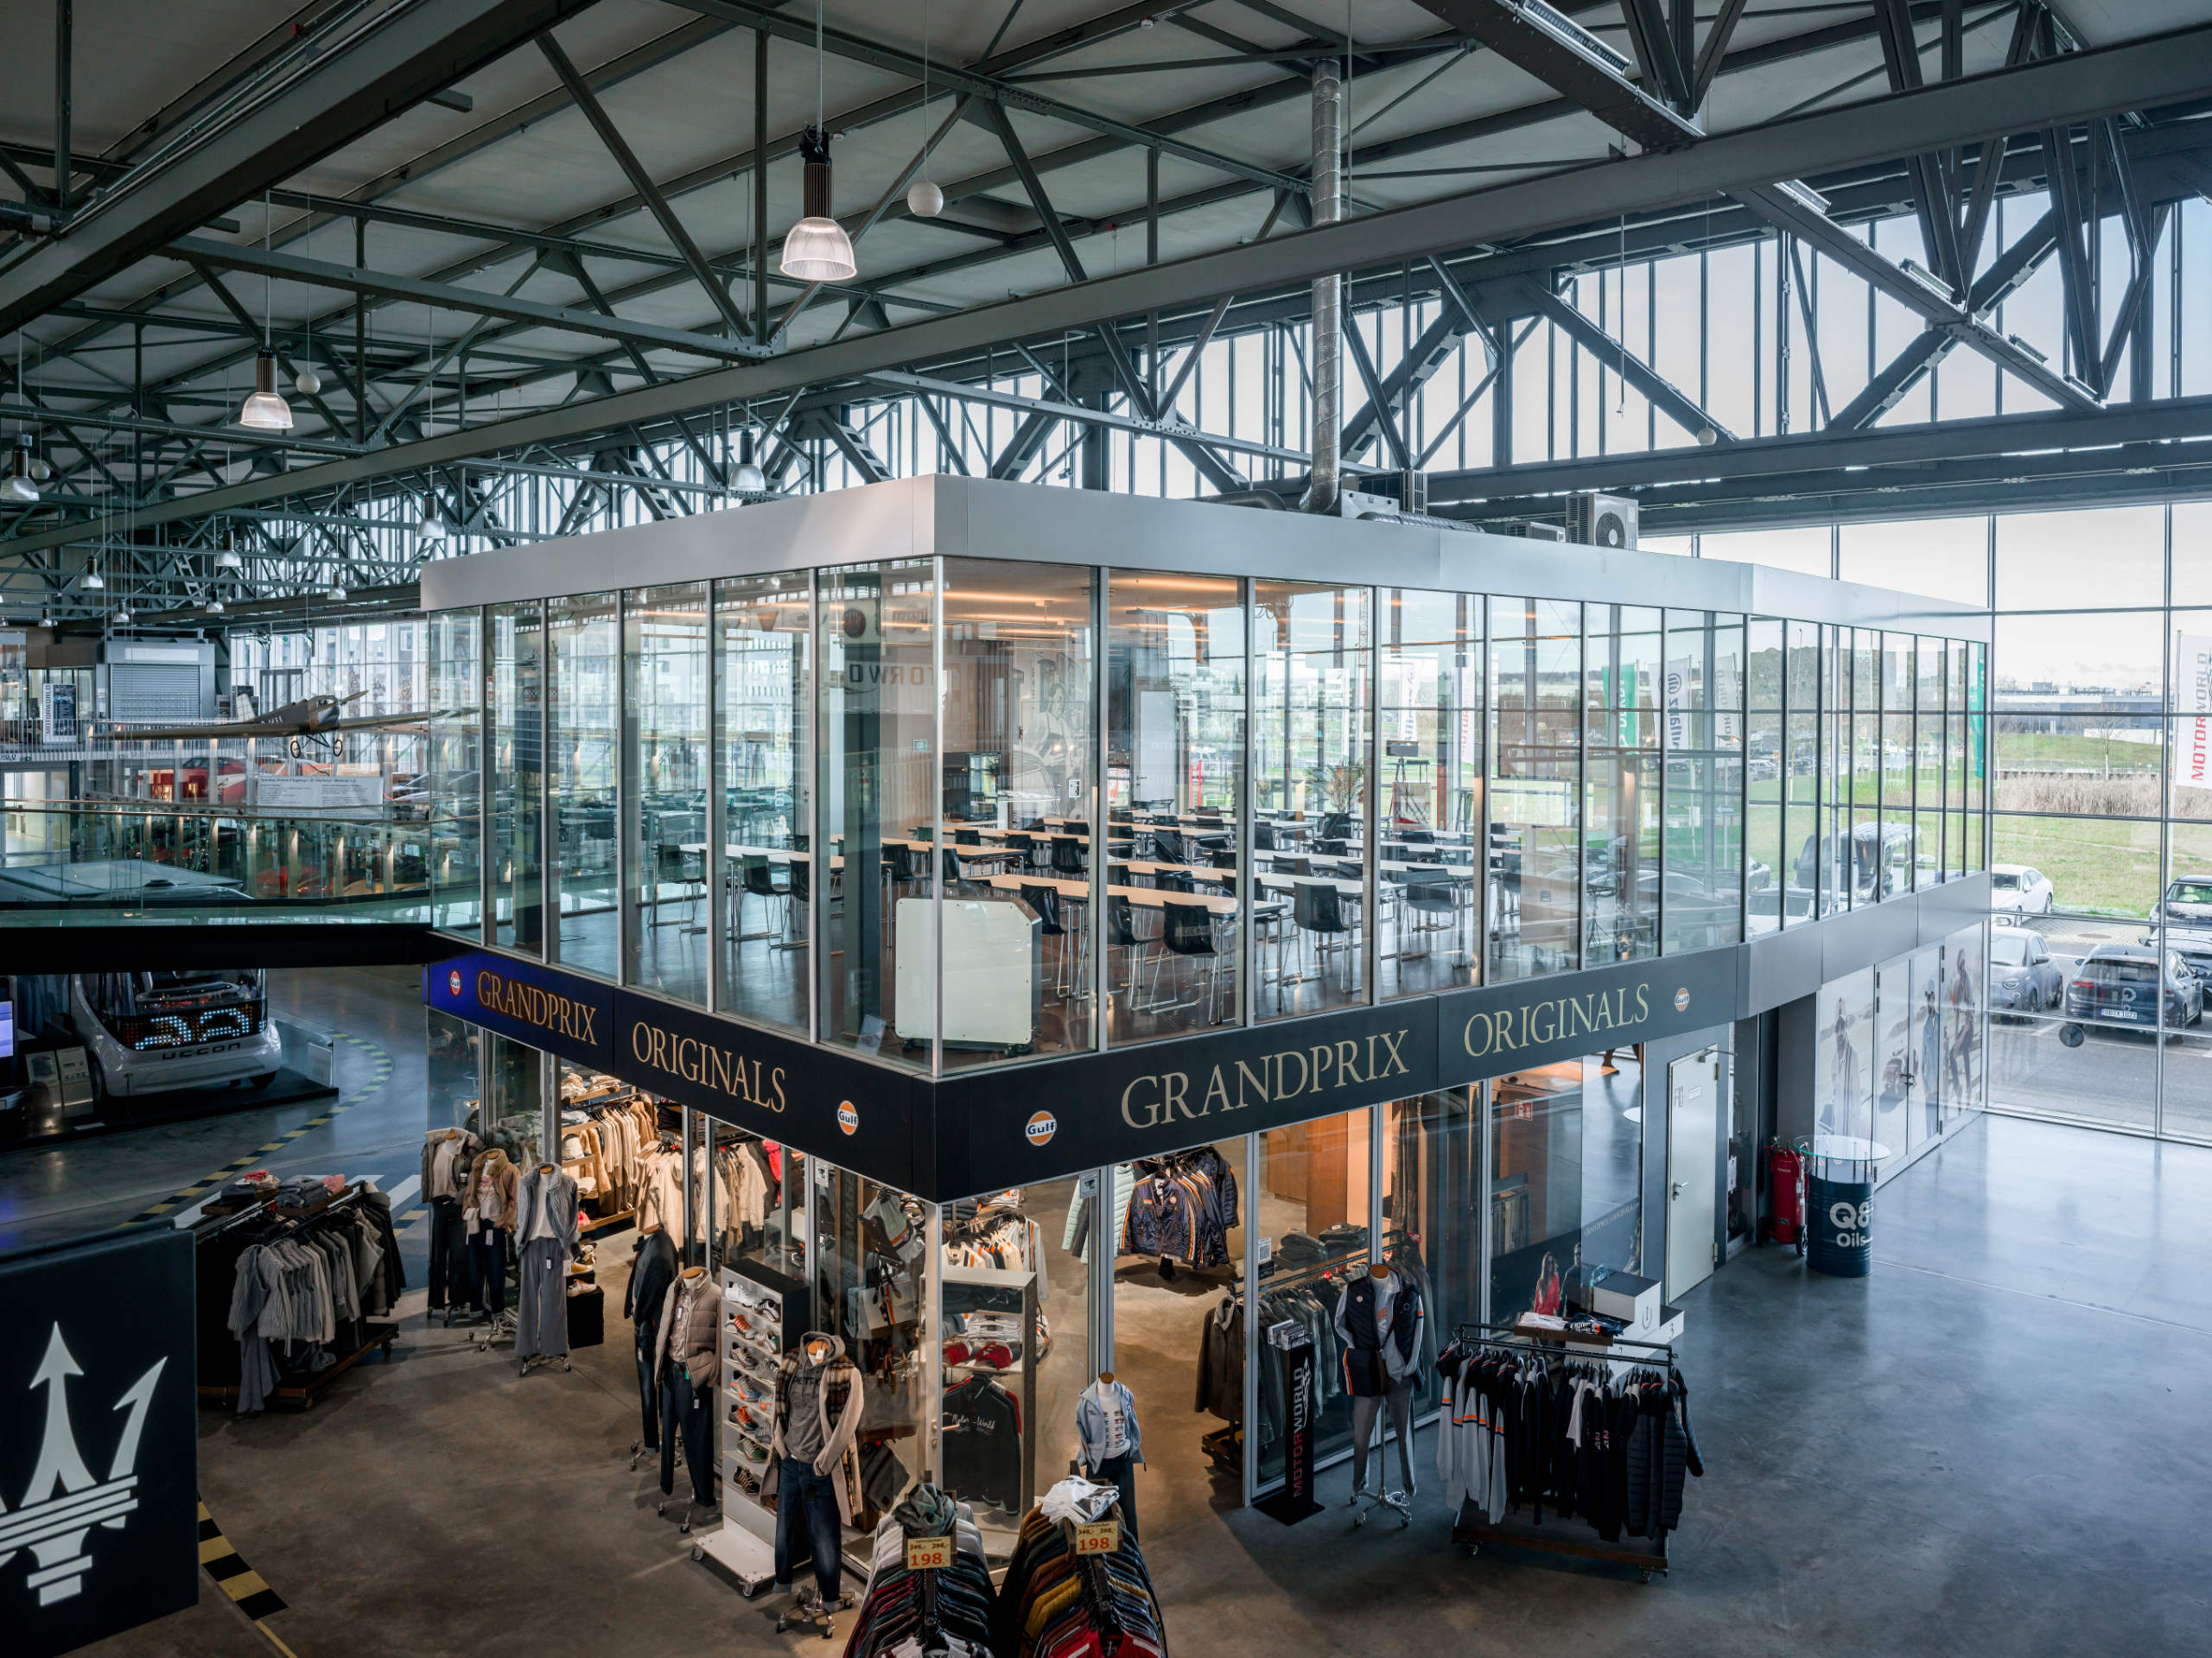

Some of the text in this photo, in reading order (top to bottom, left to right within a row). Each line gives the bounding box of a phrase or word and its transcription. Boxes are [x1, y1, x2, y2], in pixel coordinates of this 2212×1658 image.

[2190, 652, 2208, 780] MOTORWORLD
[477, 970, 786, 1114] GRANDPRIX ORIGINALS
[1121, 982, 1650, 1130] GRANDPRIX ORIGINALS
[838, 1110, 858, 1125] Gulf
[1026, 1121, 1056, 1137] Gulf
[1829, 1202, 1872, 1230] Q8
[1836, 1231, 1866, 1248] Oils
[1293, 1367, 1304, 1498] MOTORWORLD
